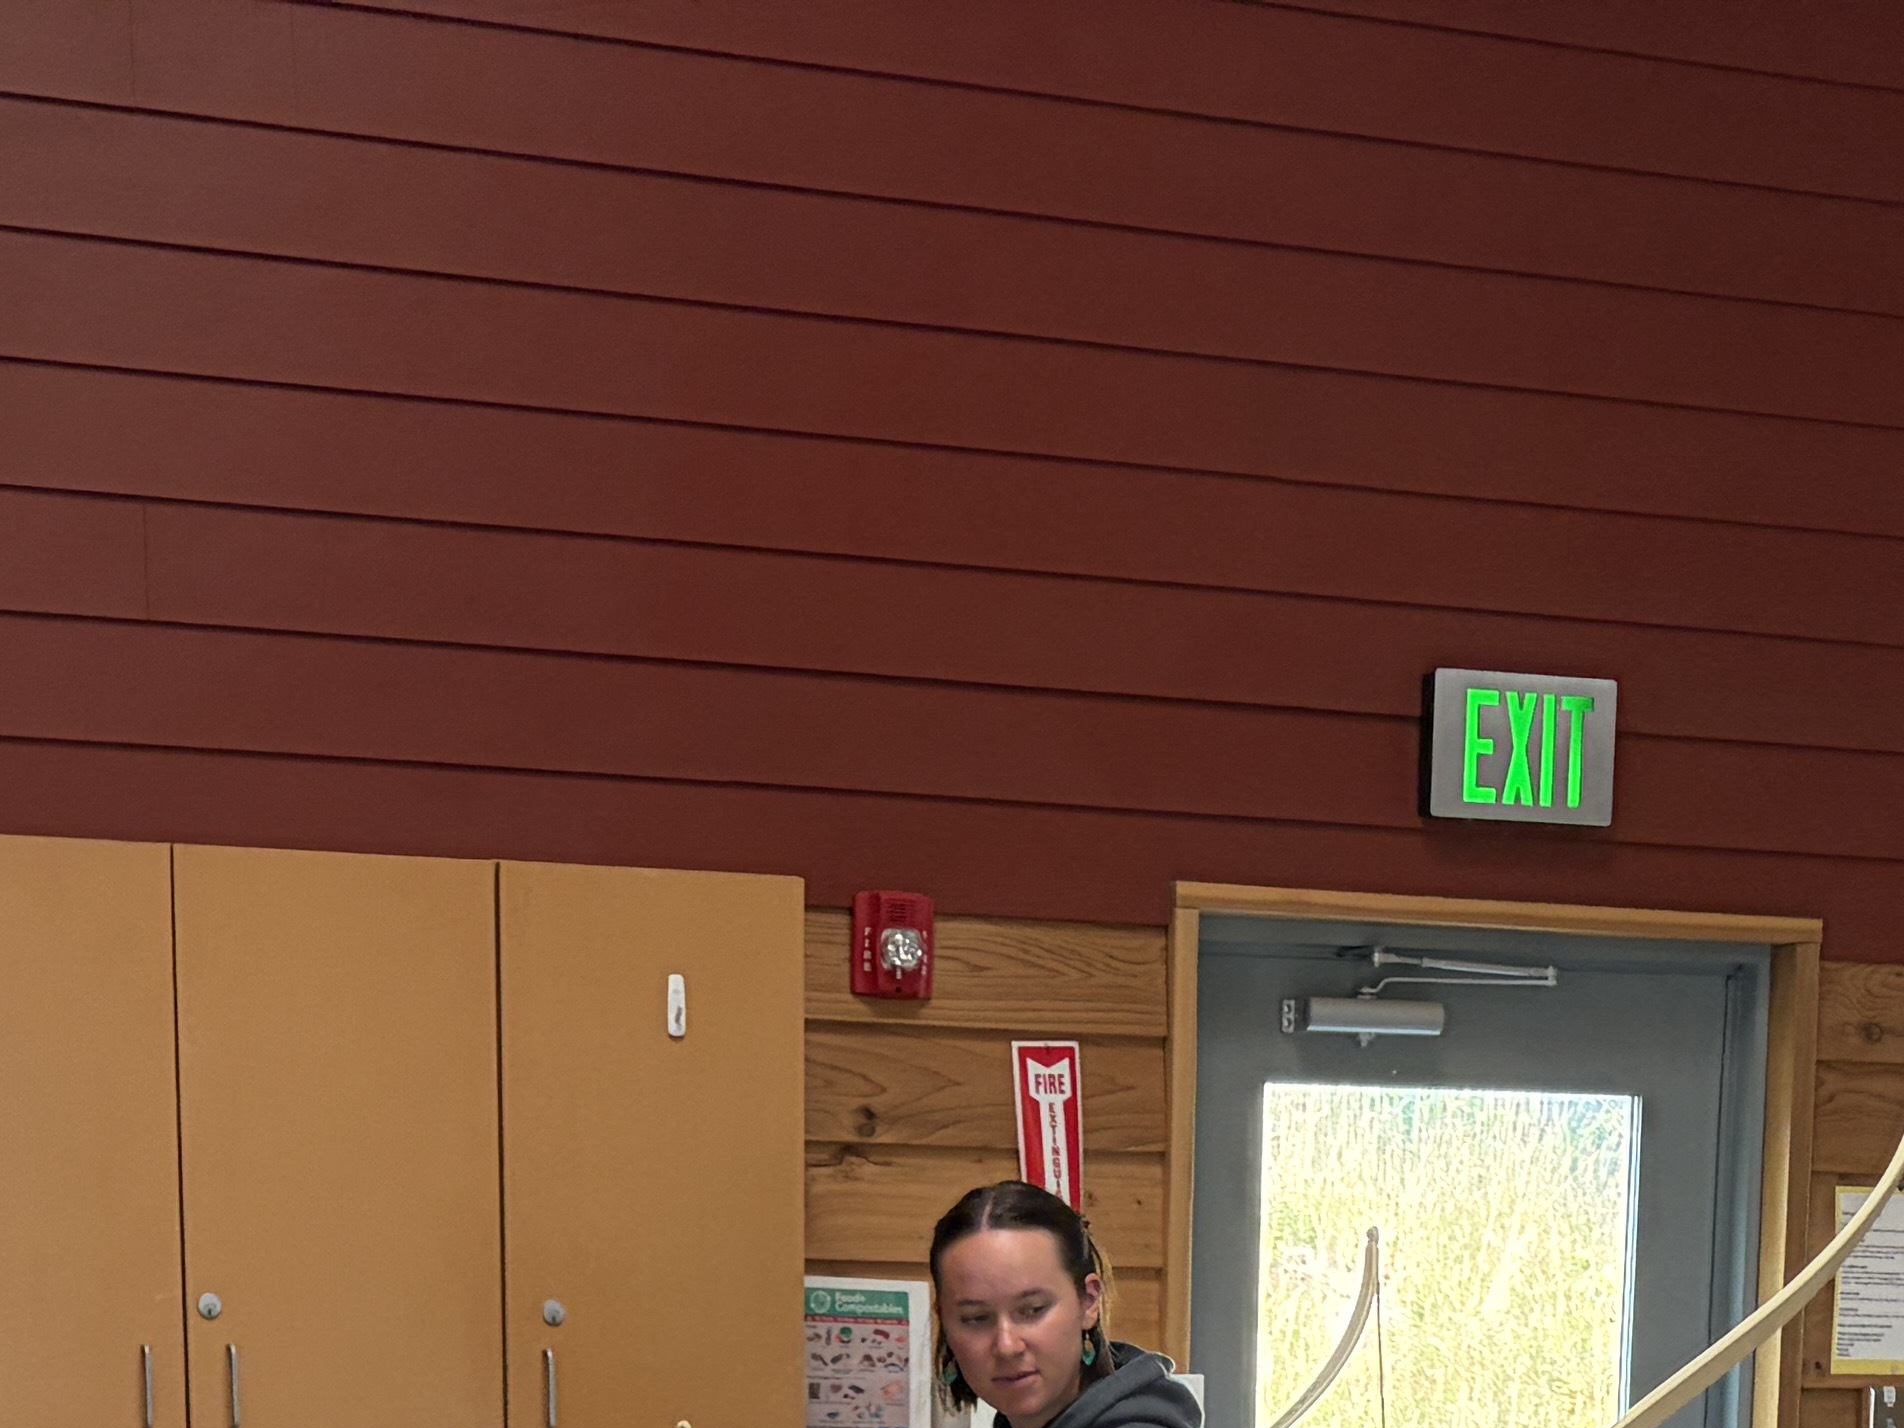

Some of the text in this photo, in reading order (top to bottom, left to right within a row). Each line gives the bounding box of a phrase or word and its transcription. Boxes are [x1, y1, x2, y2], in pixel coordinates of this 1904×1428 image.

[1462, 688, 1594, 808] EXIT
[1034, 1073, 1066, 1095] FIRE
[1048, 1102, 1063, 1199] EXTINGUIS
